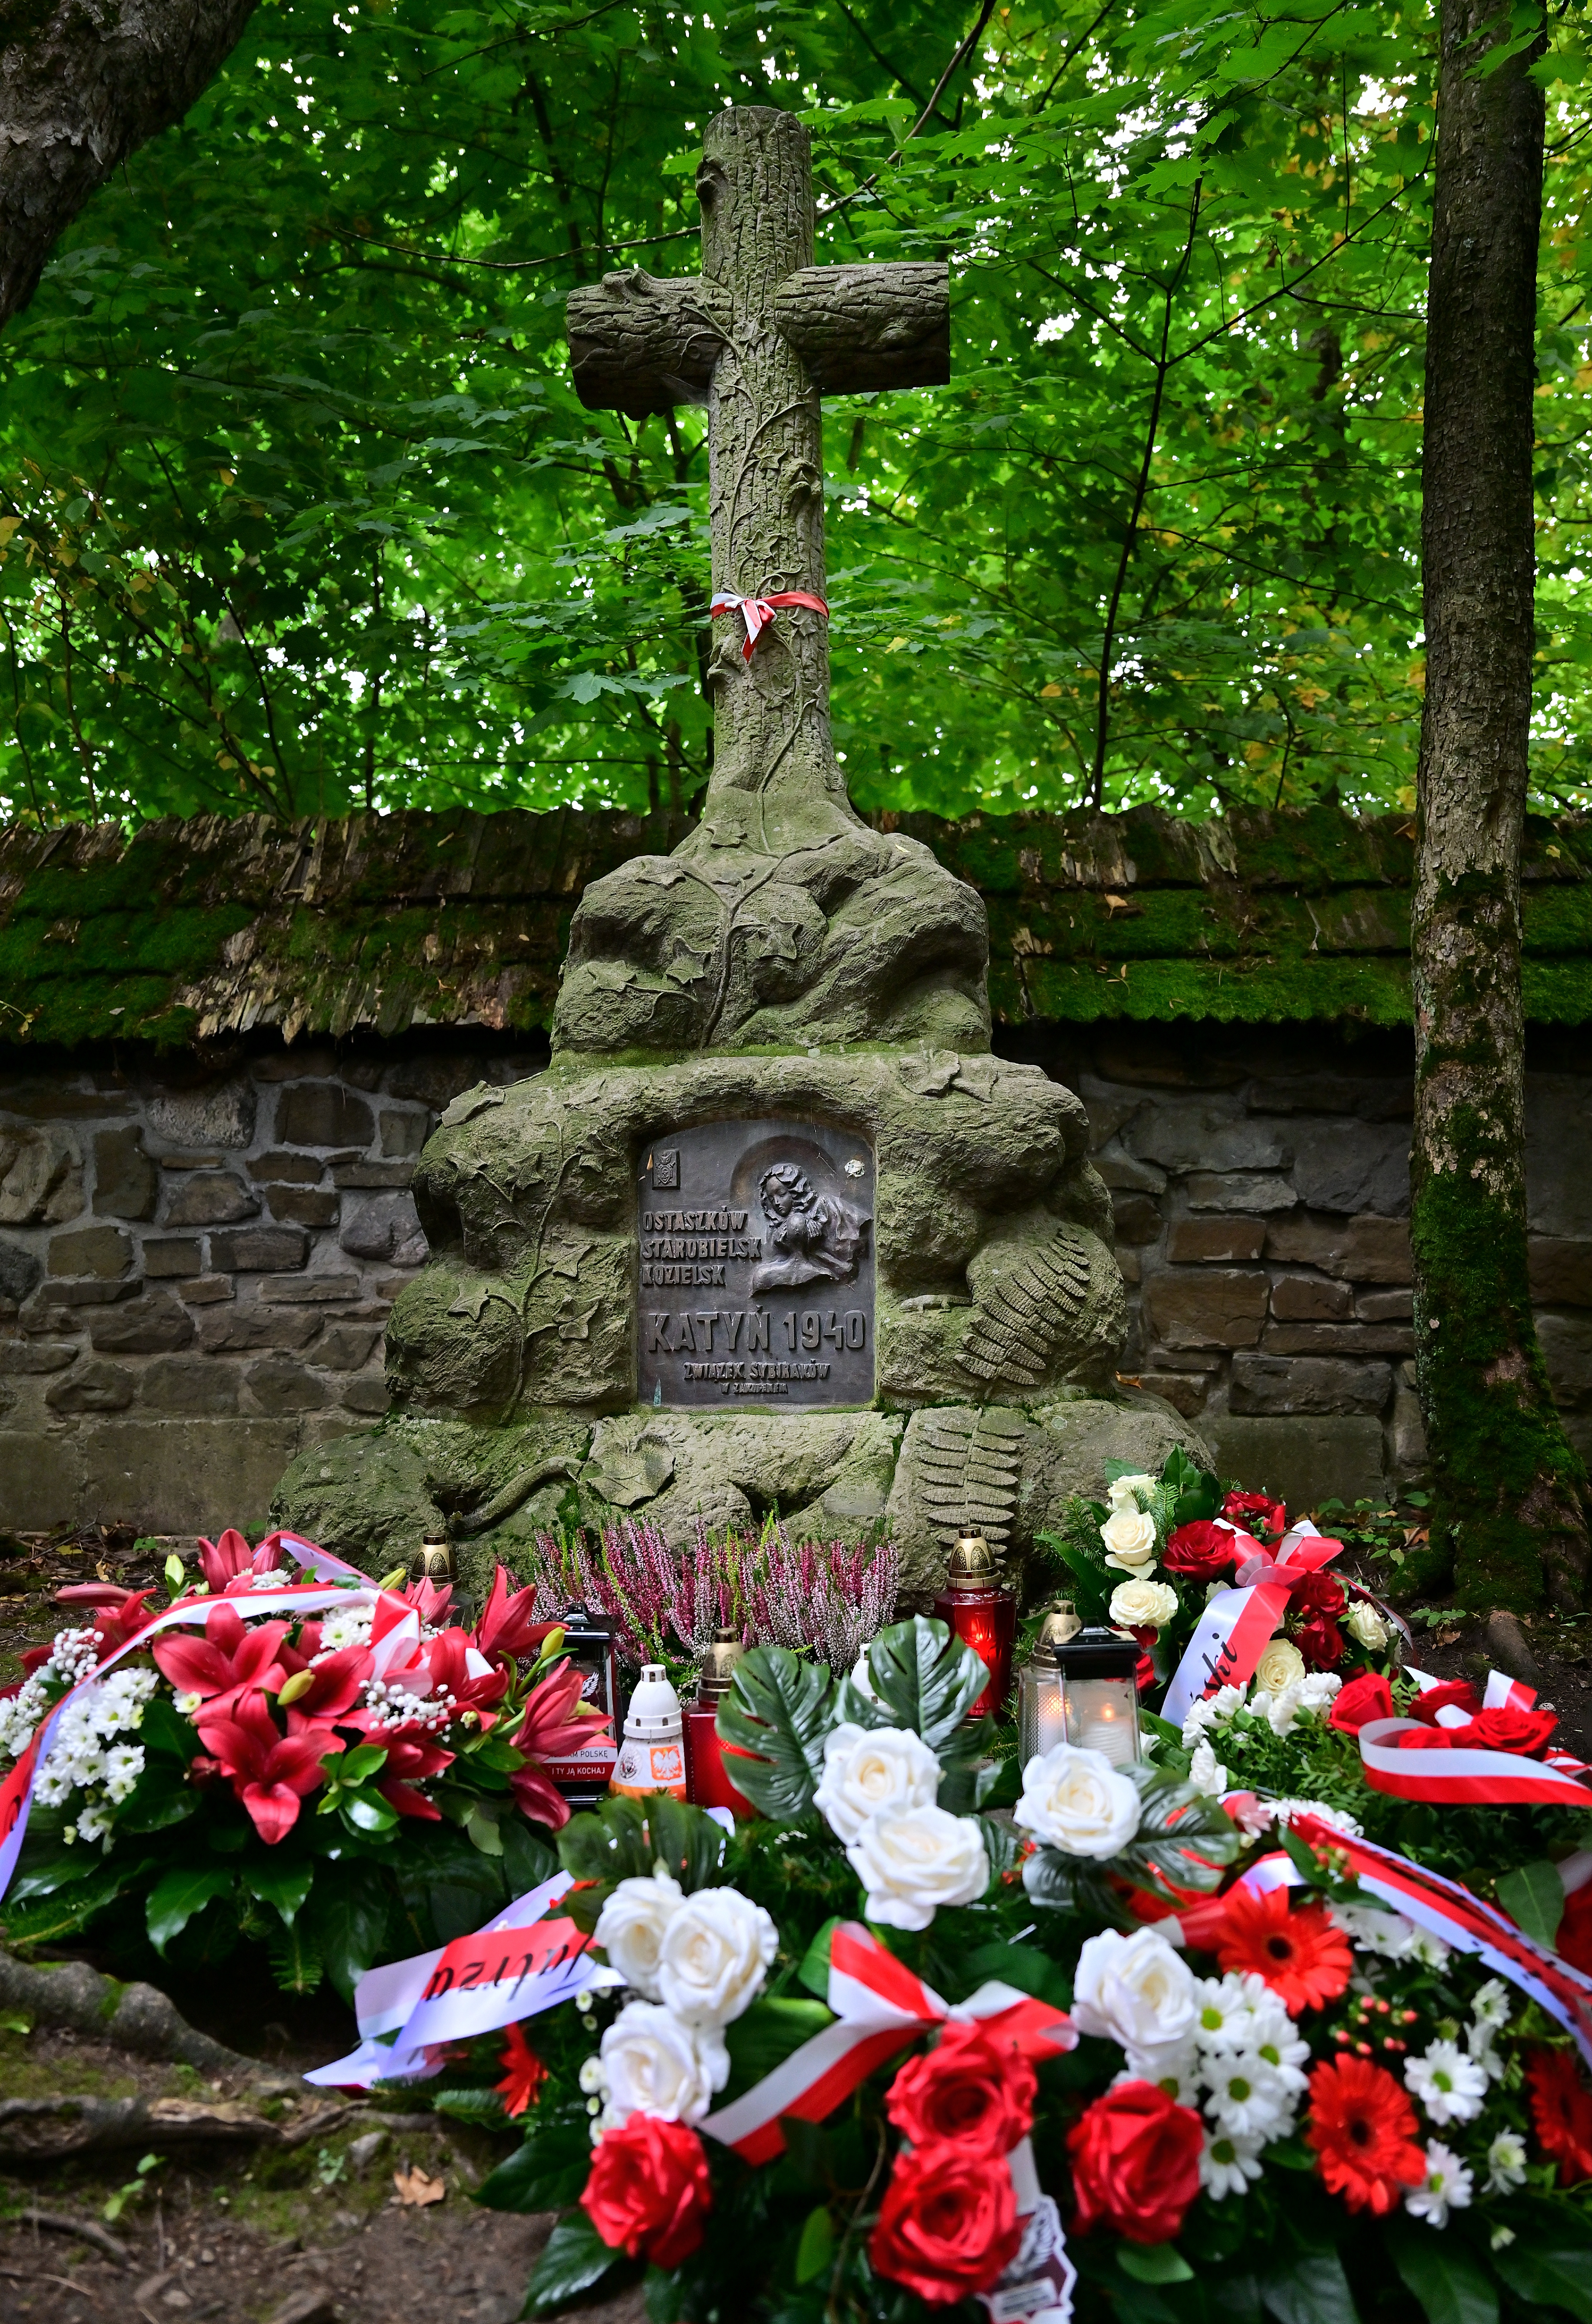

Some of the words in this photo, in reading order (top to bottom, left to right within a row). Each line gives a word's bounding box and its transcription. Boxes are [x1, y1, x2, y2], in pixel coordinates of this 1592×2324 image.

[643, 1206, 748, 1230] OSTASZKÓW
[642, 1238, 761, 1258] STAROBIELSK
[642, 1264, 725, 1285] KOZIELSK
[648, 1305, 770, 1351] KATYŃ
[783, 1311, 865, 1349] 1940
[684, 1361, 746, 1382] ZWIĄZEK
[750, 1359, 830, 1379] SYBIRAKÓW
[720, 1382, 729, 1393] W
[734, 1383, 788, 1393] ZAKOPANEM
[581, 1750, 608, 1758] POLSKĘ
[567, 1767, 575, 1776] JĄ
